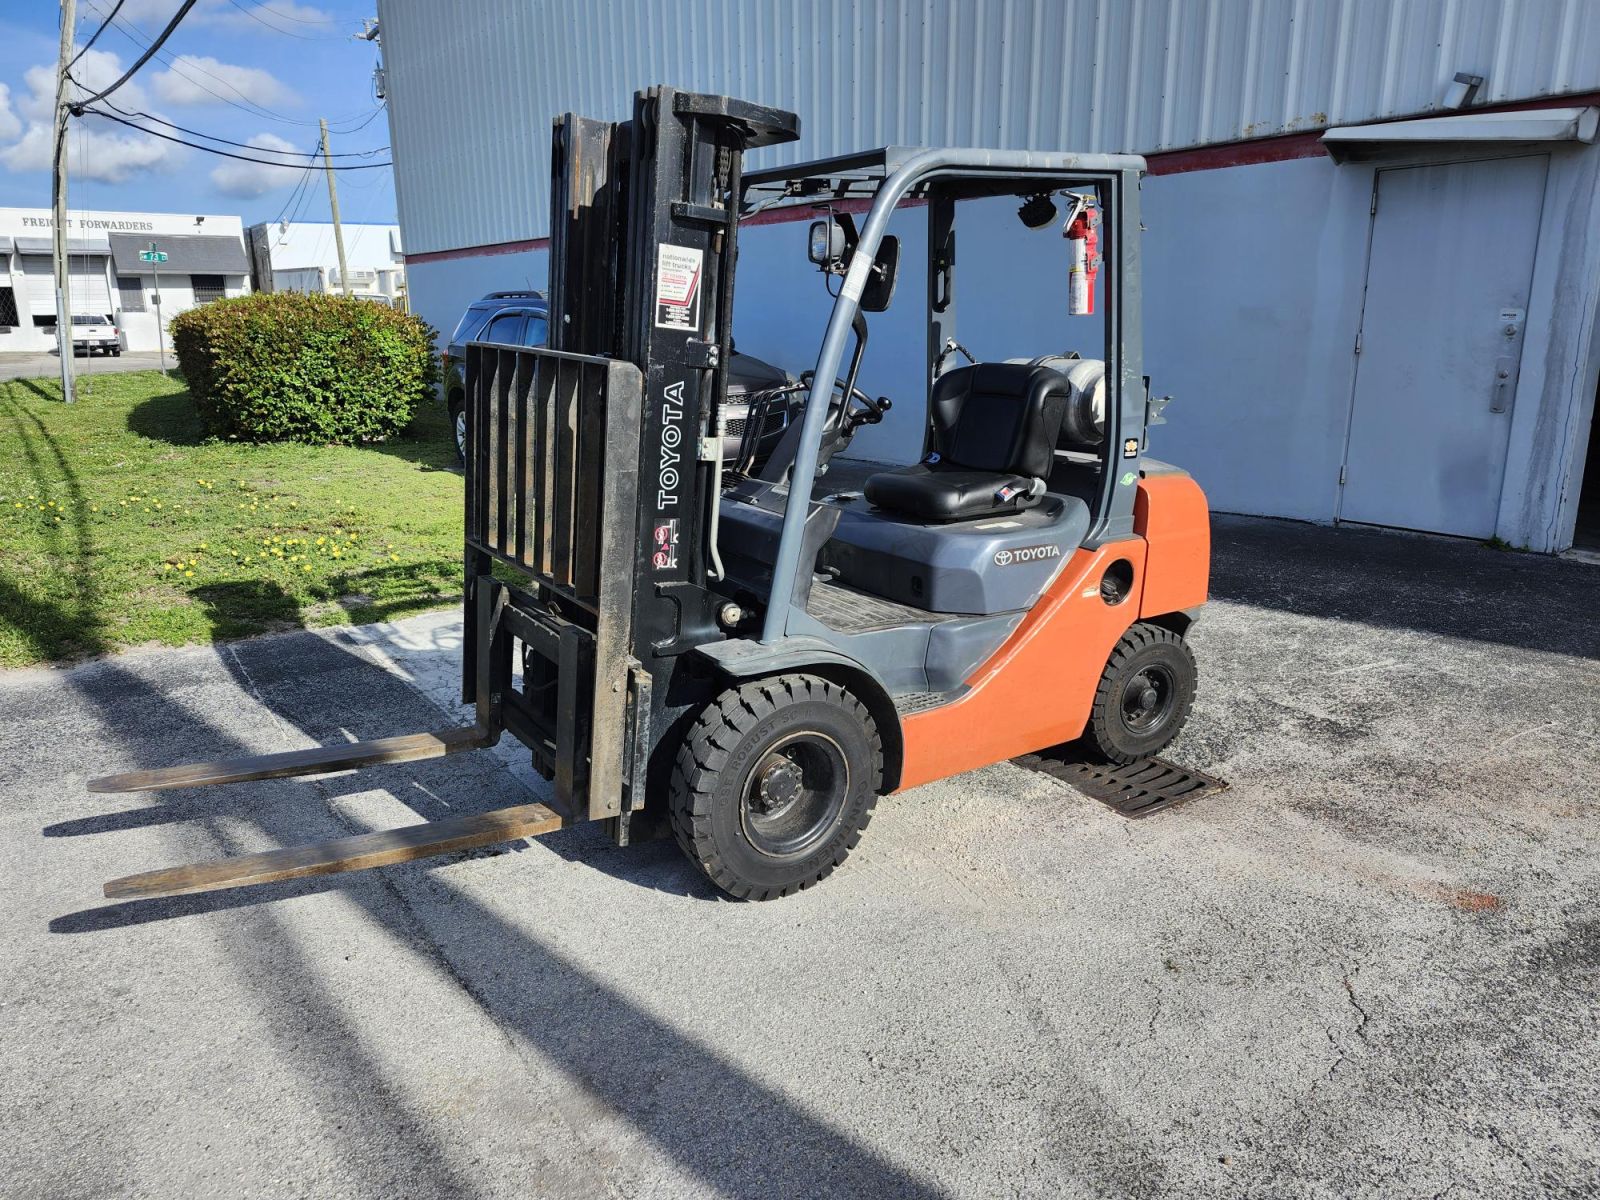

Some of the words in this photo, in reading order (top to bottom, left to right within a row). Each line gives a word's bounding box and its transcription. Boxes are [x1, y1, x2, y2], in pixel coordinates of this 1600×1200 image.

[22, 217, 73, 228] FREIT
[80, 219, 153, 231] FORWARDERS
[657, 381, 685, 511] TOYOTA
[1014, 545, 1060, 561] TOYOTA
[732, 720, 776, 769] ROBUST
[793, 779, 868, 873] CONTINENT
